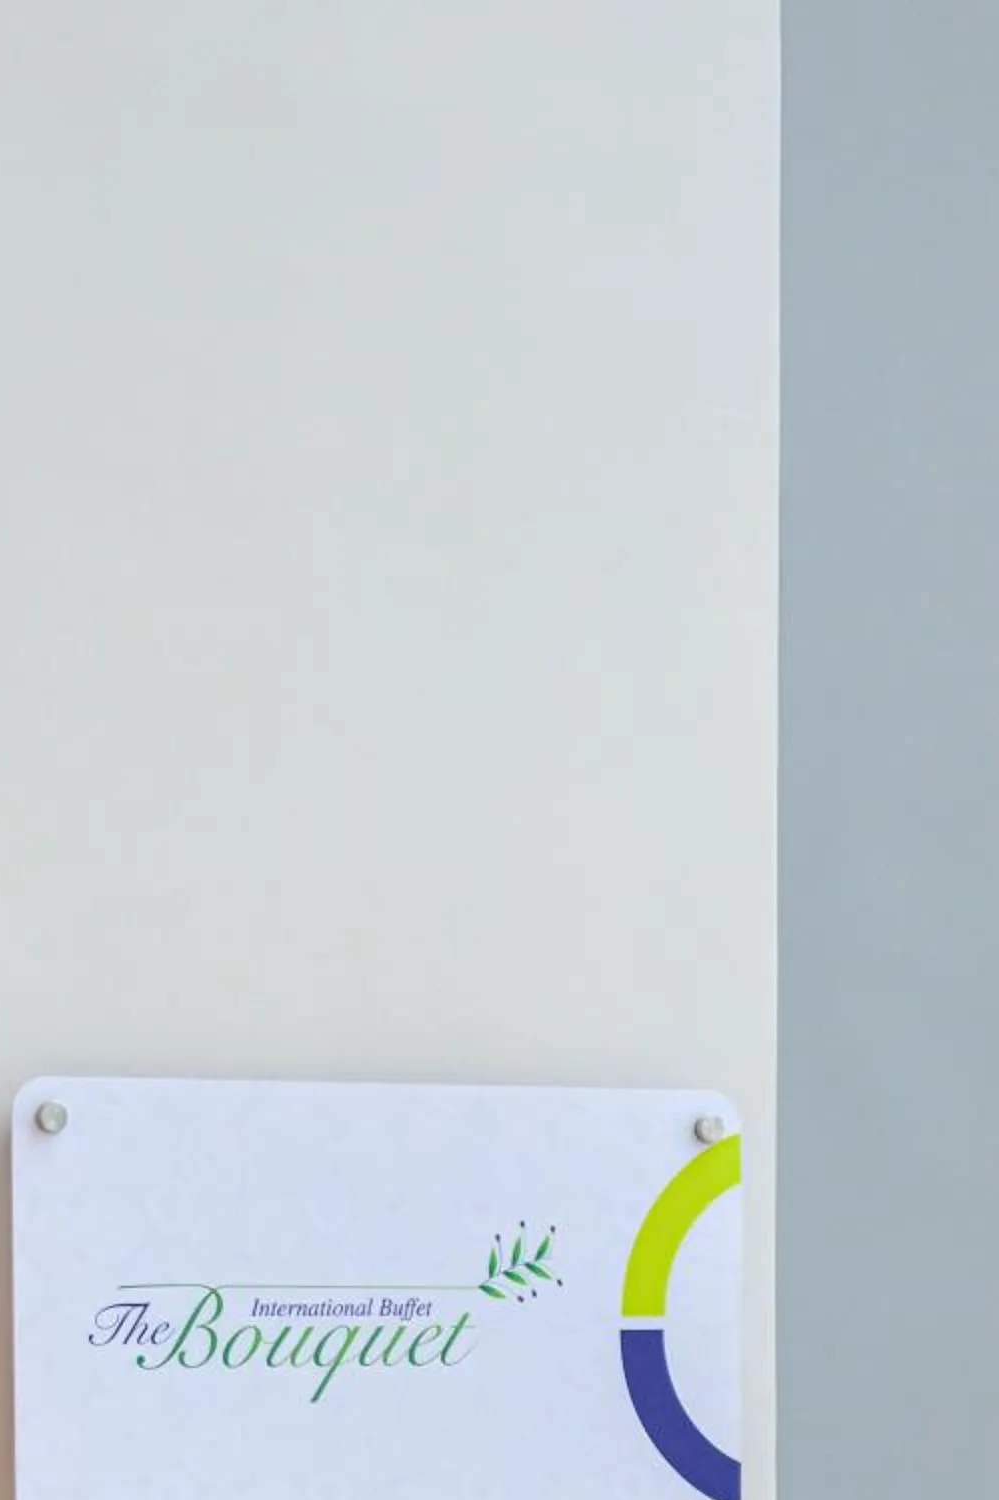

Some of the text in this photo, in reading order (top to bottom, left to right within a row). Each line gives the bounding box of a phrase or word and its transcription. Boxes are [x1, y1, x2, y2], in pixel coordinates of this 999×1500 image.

[88, 1286, 479, 1404] The Bouquet
[250, 1297, 433, 1322] International Buffet
